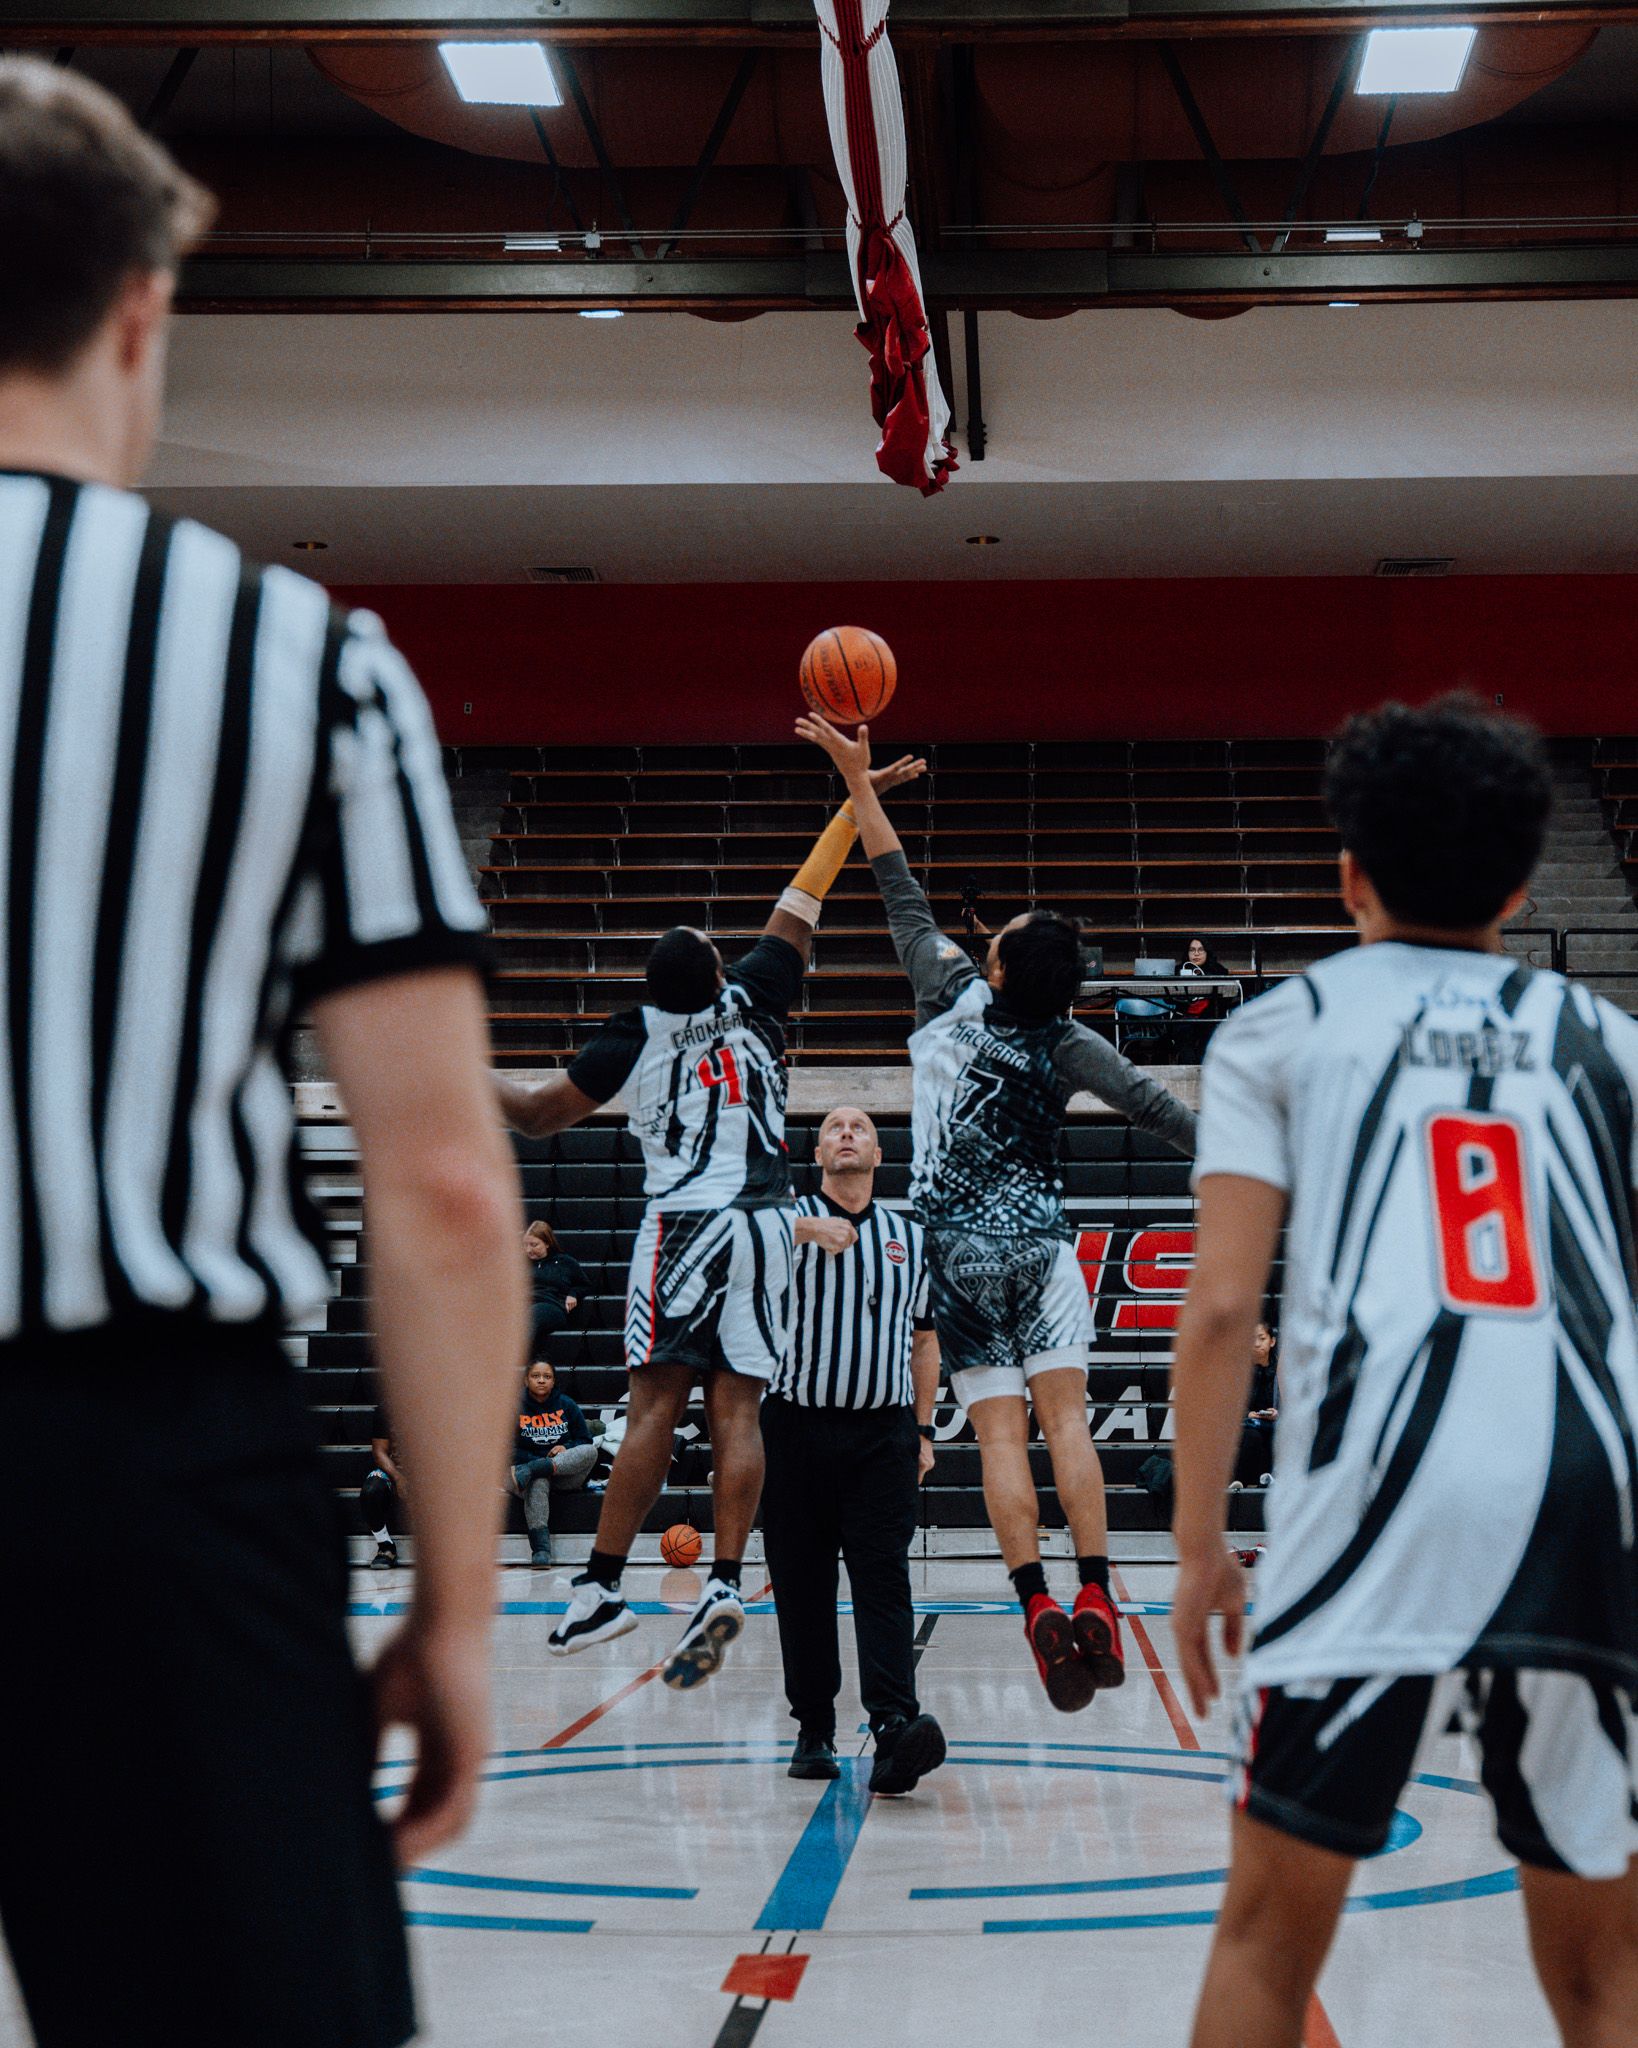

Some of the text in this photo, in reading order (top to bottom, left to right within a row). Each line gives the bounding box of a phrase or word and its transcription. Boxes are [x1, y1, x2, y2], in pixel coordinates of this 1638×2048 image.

[671, 1012, 743, 1050] CROMER
[949, 1023, 1030, 1070] MACLANG
[1400, 1023, 1536, 1072] LOPEZ
[695, 1044, 748, 1109] 4
[950, 1062, 1004, 1126] 7
[1426, 1113, 1545, 1313] 8
[520, 1409, 564, 1428] POLY
